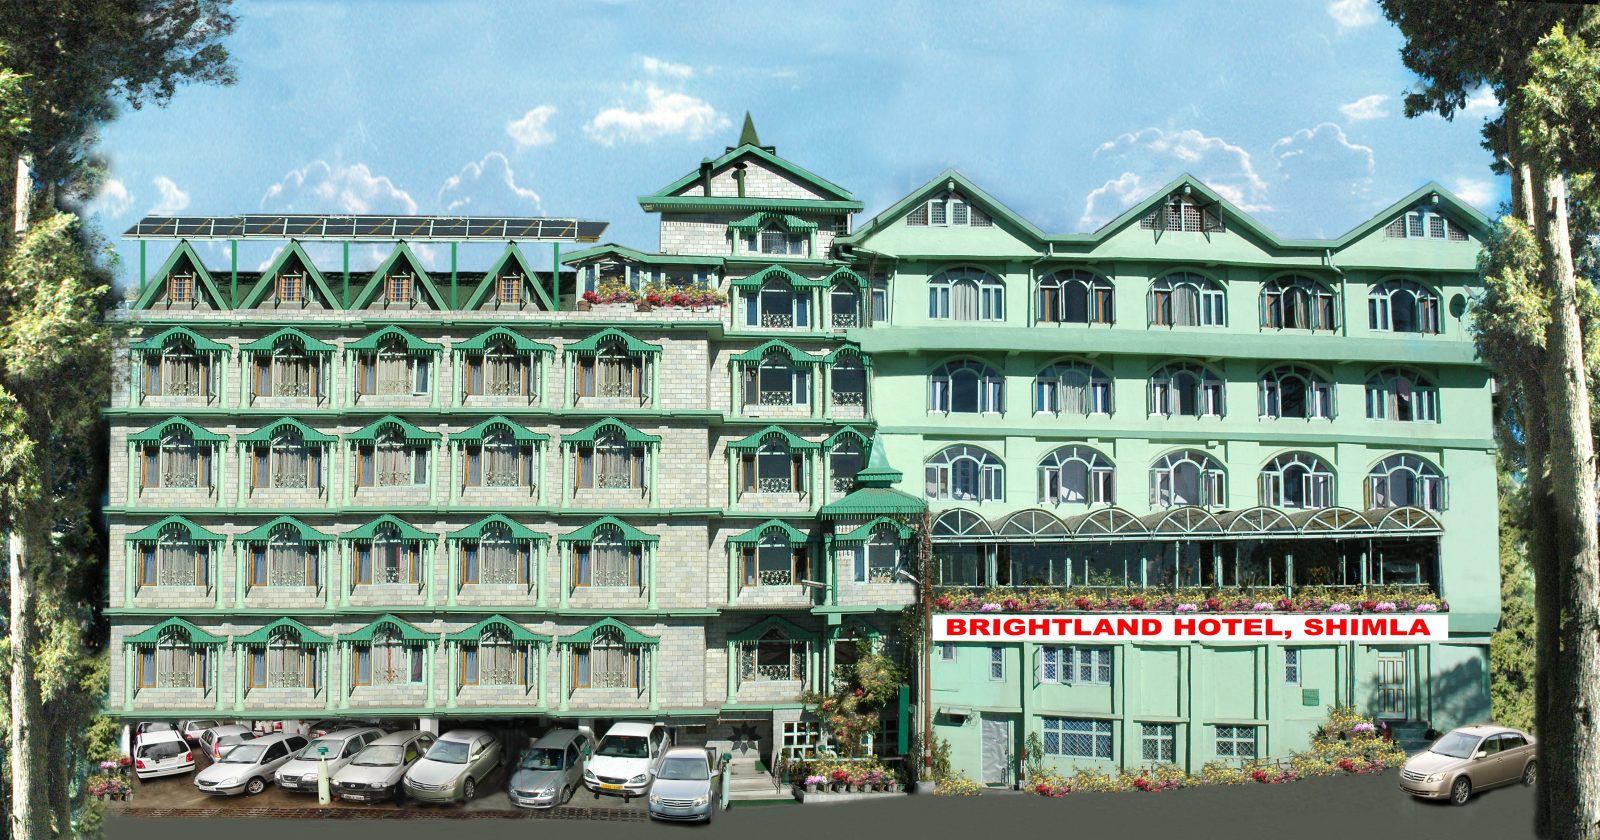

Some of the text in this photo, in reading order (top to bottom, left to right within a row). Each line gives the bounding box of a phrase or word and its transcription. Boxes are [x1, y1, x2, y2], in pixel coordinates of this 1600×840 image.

[946, 618, 1431, 639] BRIGHTLAND HOTEL, SHIMLA
